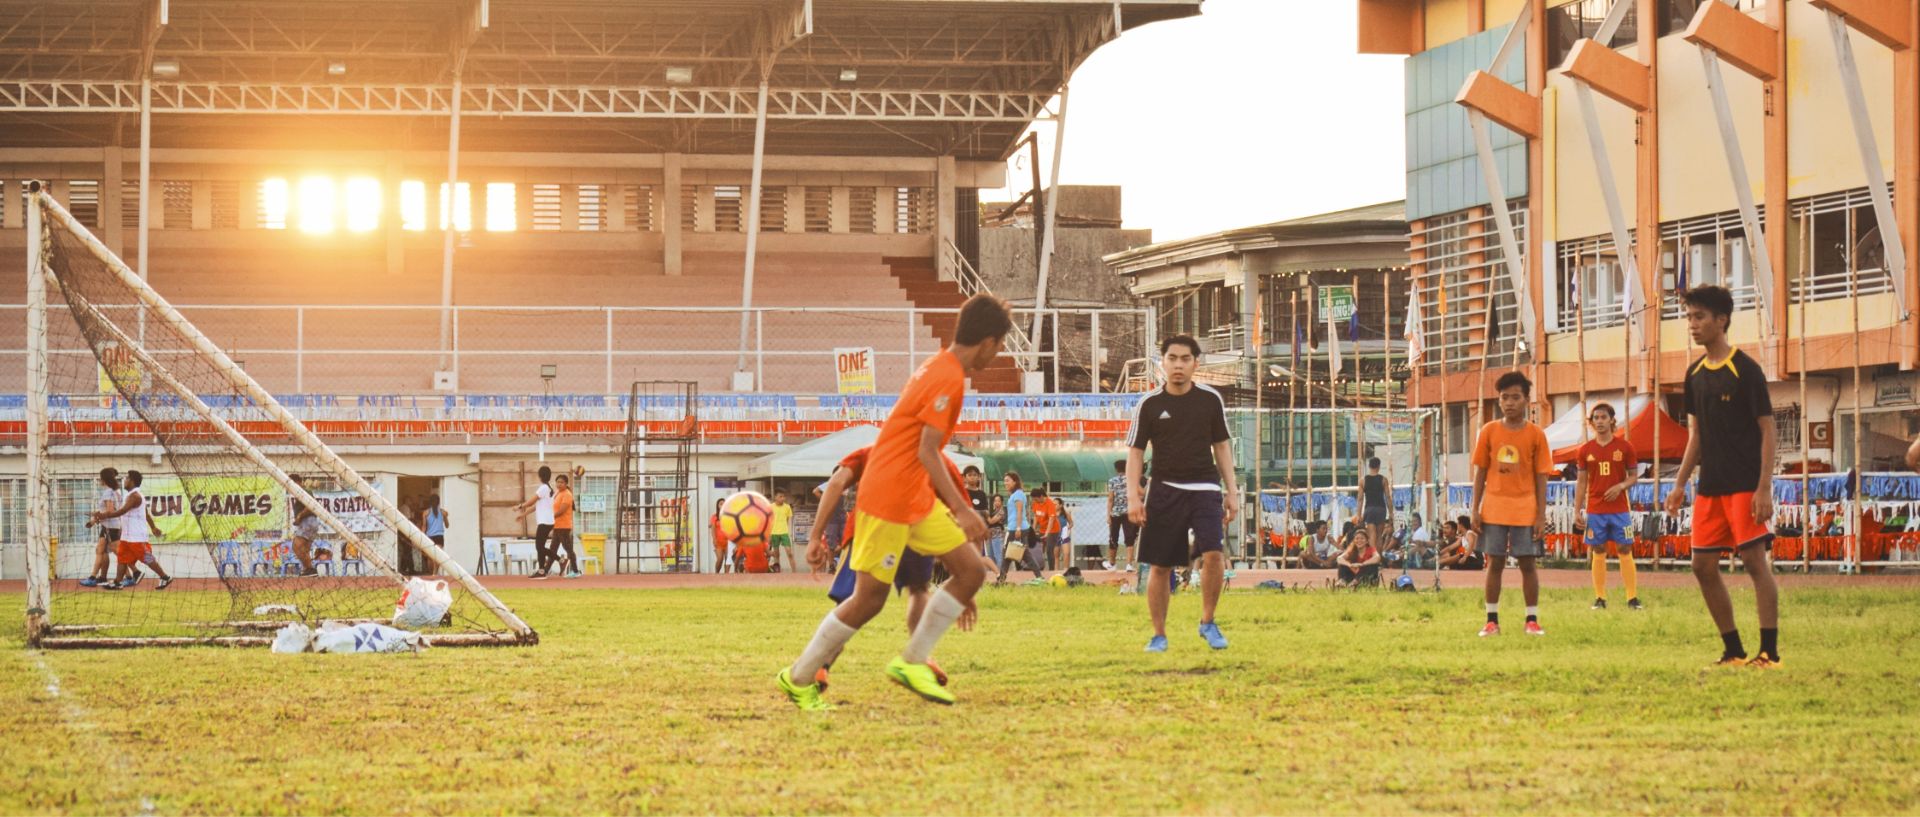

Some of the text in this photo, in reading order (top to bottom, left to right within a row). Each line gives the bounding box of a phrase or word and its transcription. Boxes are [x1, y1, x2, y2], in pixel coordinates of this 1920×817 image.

[838, 350, 868, 373] ONE
[1813, 424, 1827, 441] G
[1599, 461, 1611, 476] 18
[190, 494, 272, 516] GAMES
[1623, 526, 1634, 540] 18
